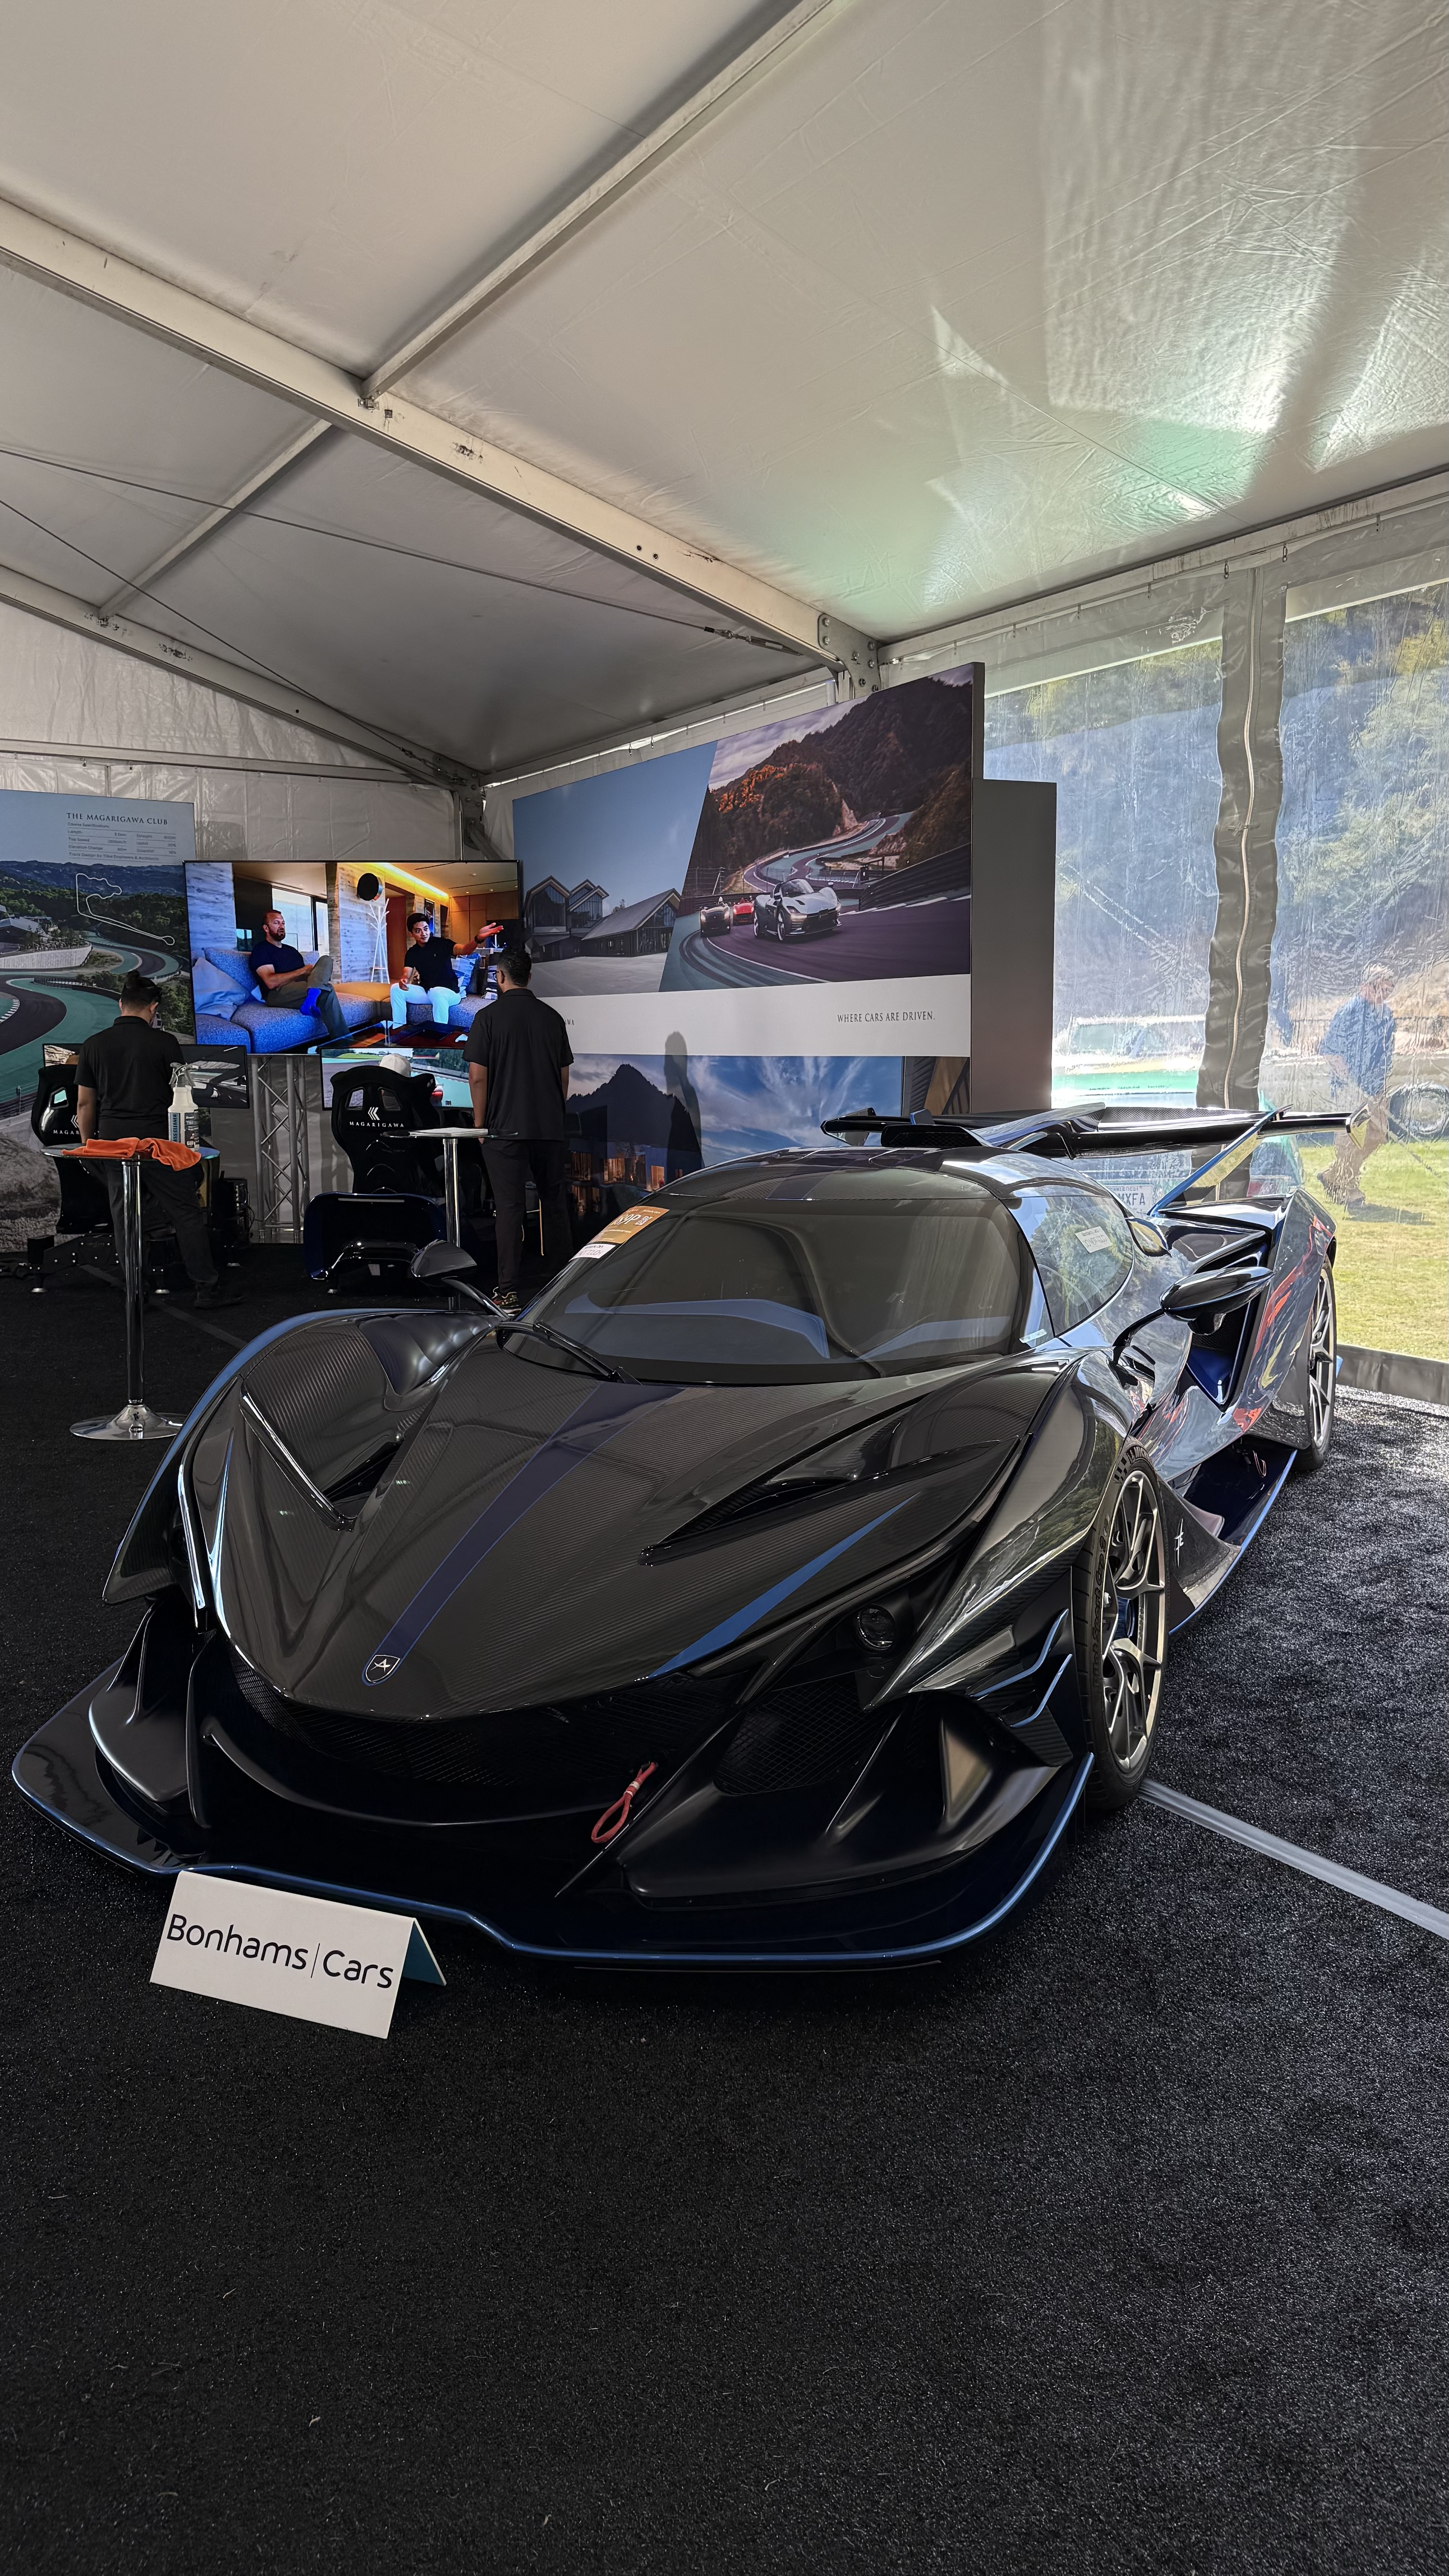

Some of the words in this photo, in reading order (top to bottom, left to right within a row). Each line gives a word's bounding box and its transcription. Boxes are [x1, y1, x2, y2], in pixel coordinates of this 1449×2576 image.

[87, 814, 144, 823] MAGARIGAWA
[837, 1014, 862, 1022] WHERE
[865, 1013, 883, 1021] CARS
[886, 1012, 900, 1021] ARE
[903, 1011, 935, 1021] DRIVEN.
[1099, 1536, 1107, 1552] 2
[1096, 1553, 1105, 1586] Cup
[166, 1914, 308, 1969] Bonhams
[323, 1950, 394, 1989] Cars
